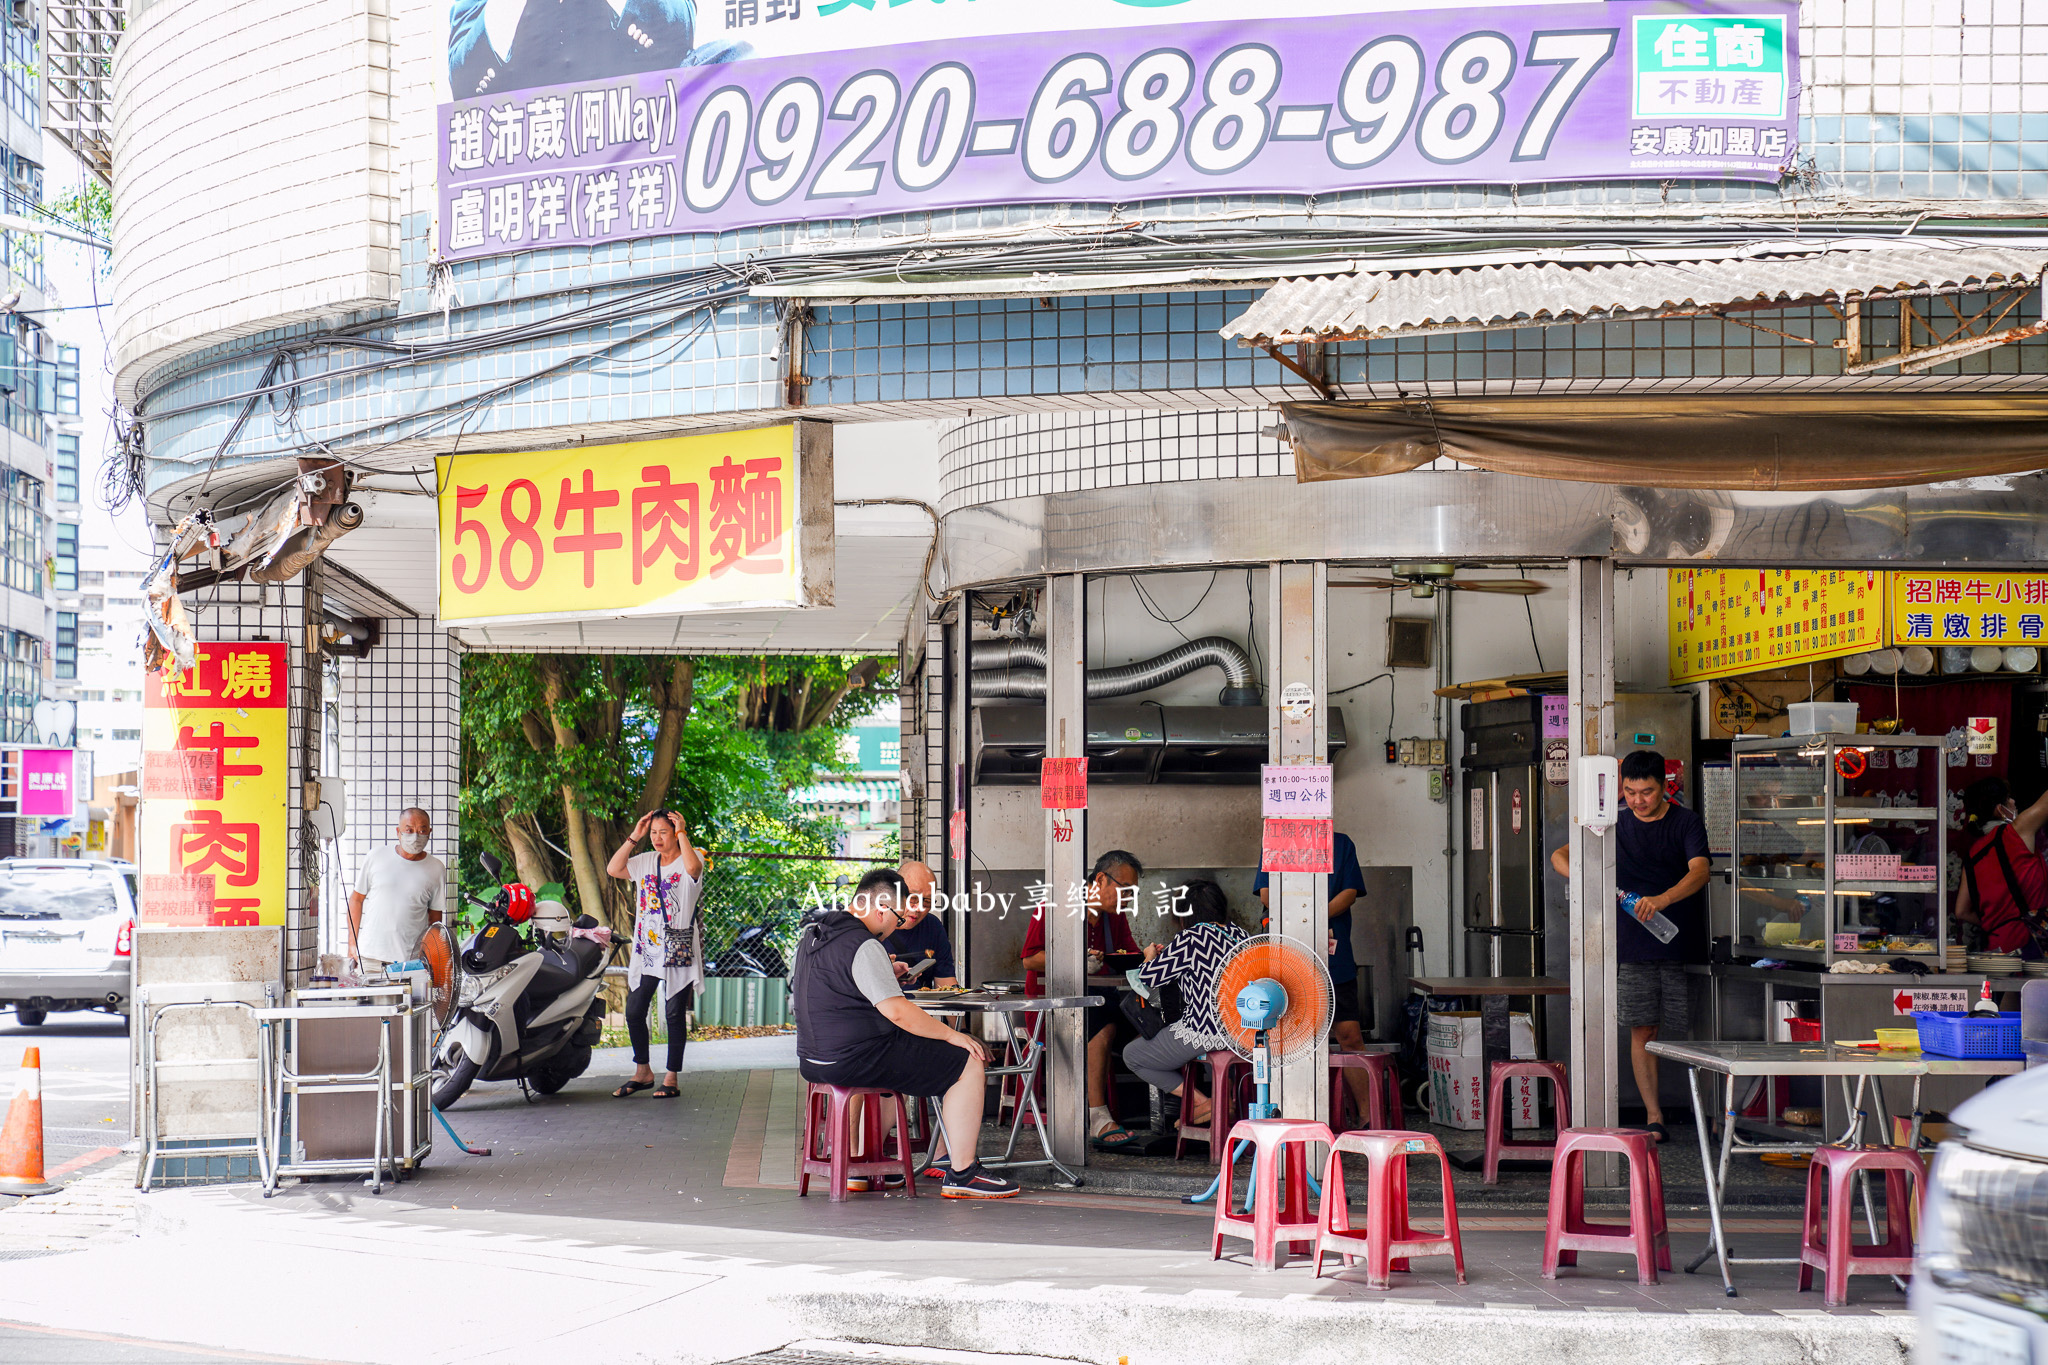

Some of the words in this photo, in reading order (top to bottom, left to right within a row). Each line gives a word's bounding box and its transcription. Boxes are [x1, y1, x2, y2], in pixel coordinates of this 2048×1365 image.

[1654, 24, 1765, 67] 住商
[1658, 78, 1763, 105] 不動產
[448, 79, 678, 175] 趙沛葳(阿May)
[682, 27, 1620, 214] 0920-688-987
[1630, 125, 1787, 158] 安康加盟店
[452, 455, 783, 594] 58牛肉麵
[1906, 579, 2048, 604] 招牌牛小排
[1907, 613, 2044, 638] 清燉排骨
[161, 651, 272, 699] 紅燒
[147, 753, 215, 769] 紅線勿停
[147, 778, 213, 793] 常被開單
[1269, 789, 1328, 802] 週四公休
[1265, 822, 1330, 838] 紅線勿停
[1265, 848, 1330, 865] 常被開單
[145, 901, 213, 916] 常被開單
[1471, 1076, 1482, 1120] 品質保證
[1520, 1076, 1532, 1120] 分級包裝
